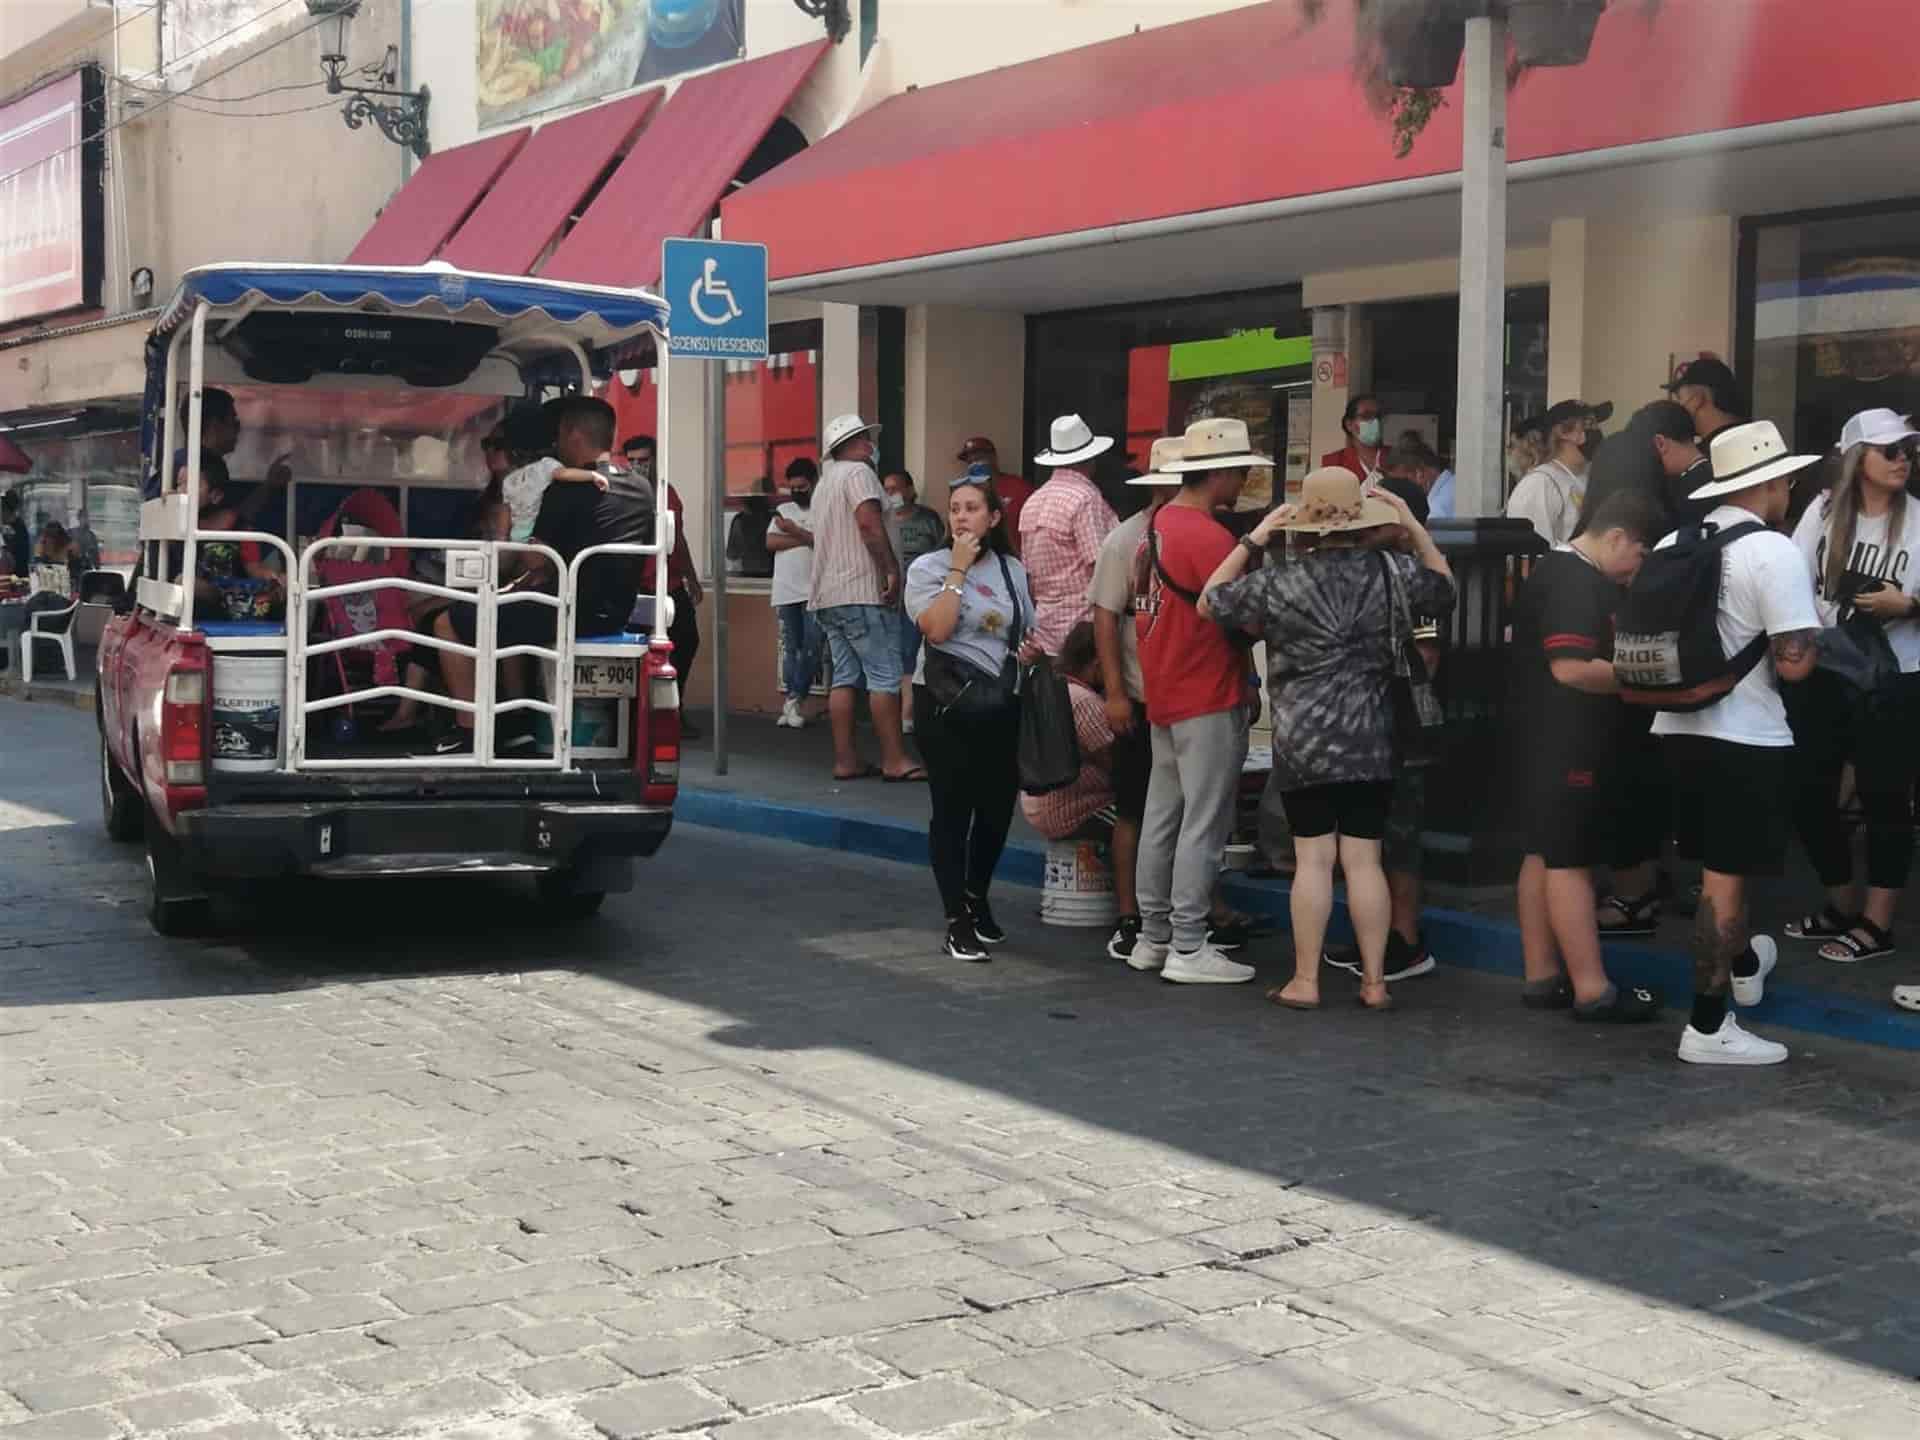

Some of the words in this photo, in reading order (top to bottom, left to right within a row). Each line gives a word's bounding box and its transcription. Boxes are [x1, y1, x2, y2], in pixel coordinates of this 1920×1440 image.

[670, 335, 710, 352] SCENSO
[719, 336, 766, 353] DESCENSO
[1616, 648, 1665, 663] RIDE
